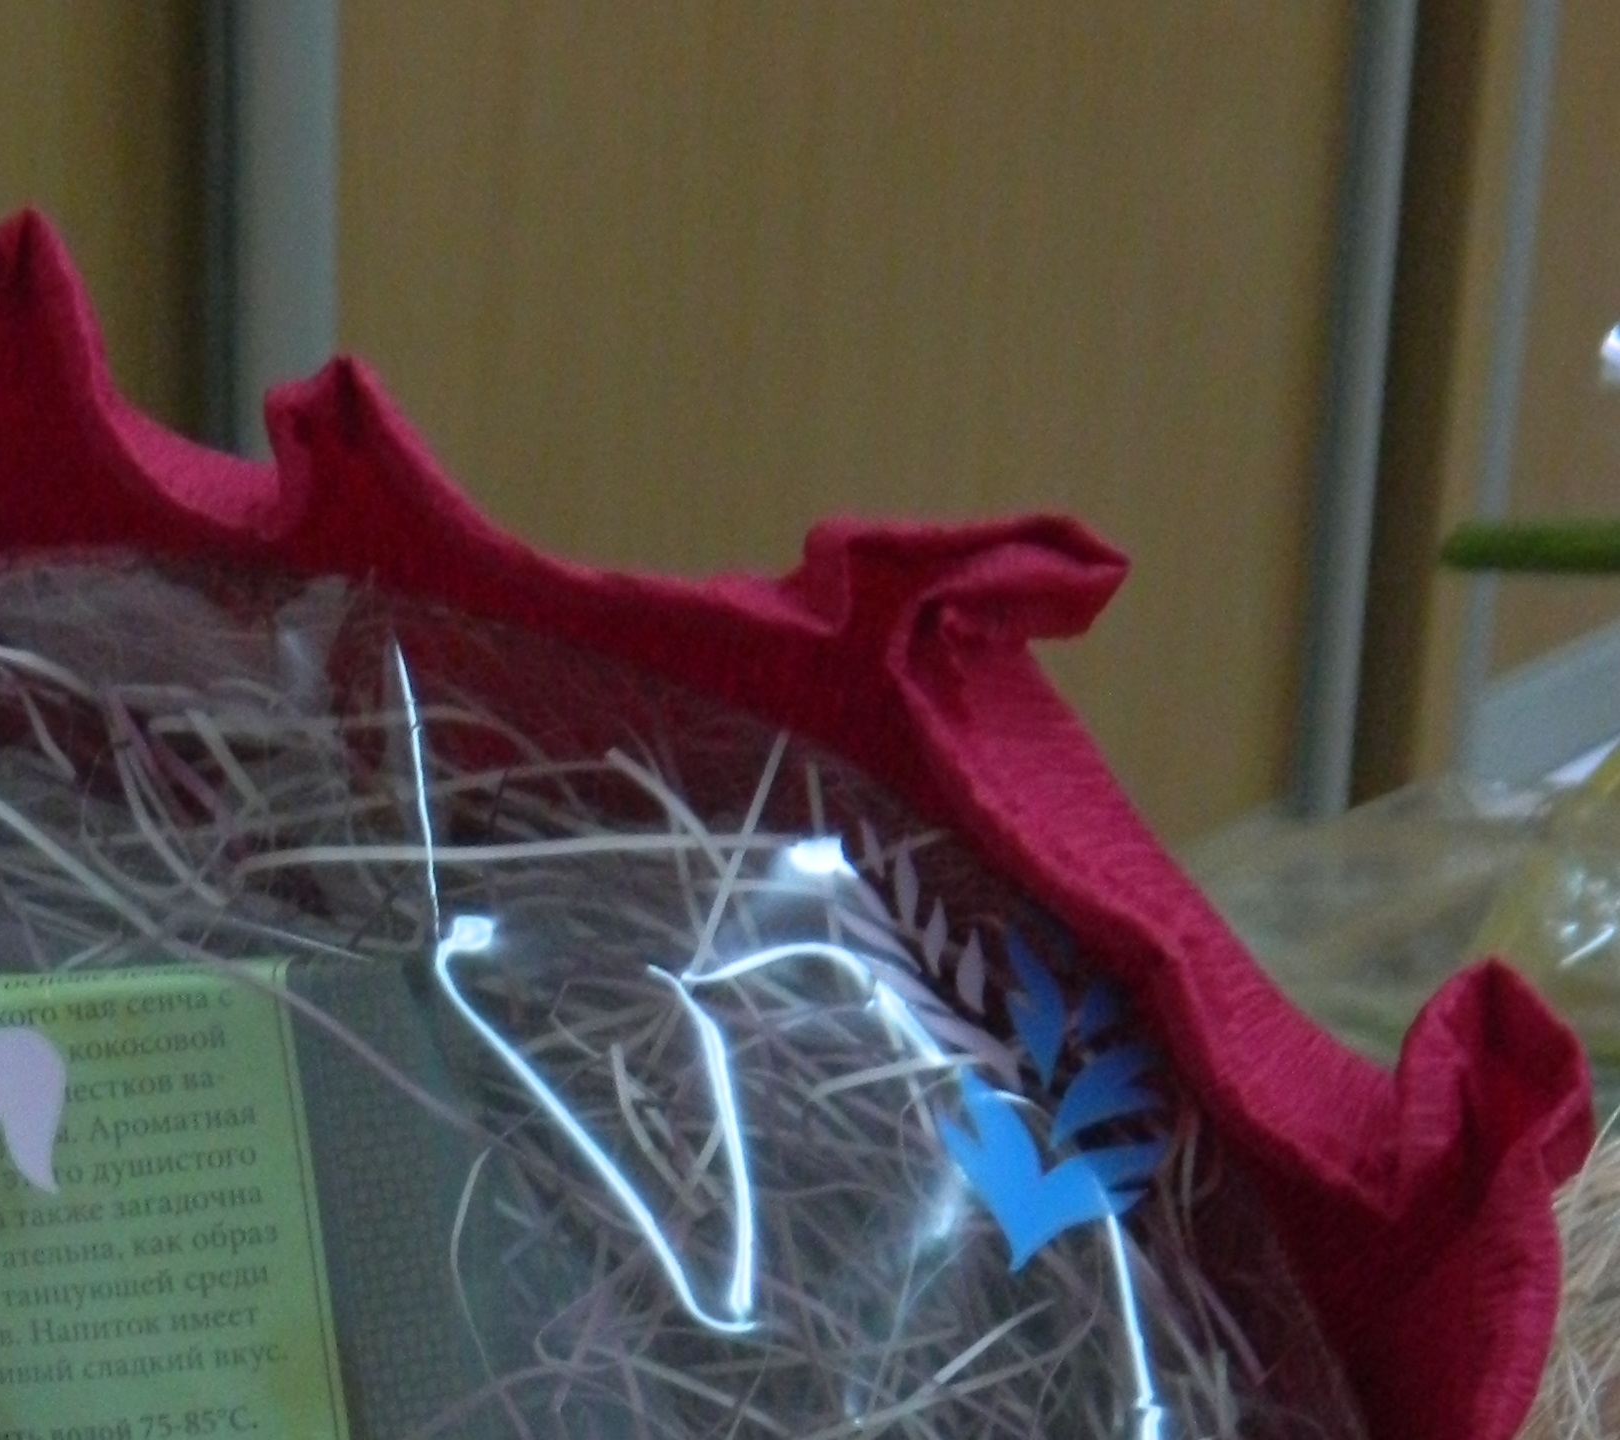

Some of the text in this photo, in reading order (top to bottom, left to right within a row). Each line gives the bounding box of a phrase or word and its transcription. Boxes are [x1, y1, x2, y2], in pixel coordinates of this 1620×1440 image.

[65, 999, 117, 1022] чая
[125, 990, 210, 1016] сенча
[69, 1028, 227, 1063] кокосовой
[90, 1104, 258, 1149] Ароматная
[92, 1145, 258, 1187] душистого
[16, 1201, 105, 1228] также
[112, 1186, 264, 1219] загадочна
[133, 1234, 183, 1258] как
[192, 1222, 280, 1256] образ
[2, 1270, 174, 1311] танцующей
[183, 1265, 270, 1299] среди
[30, 1313, 161, 1347] Напиток
[170, 1305, 261, 1330] имеет
[81, 1345, 205, 1381] сладкий
[213, 1342, 291, 1374] вкус.
